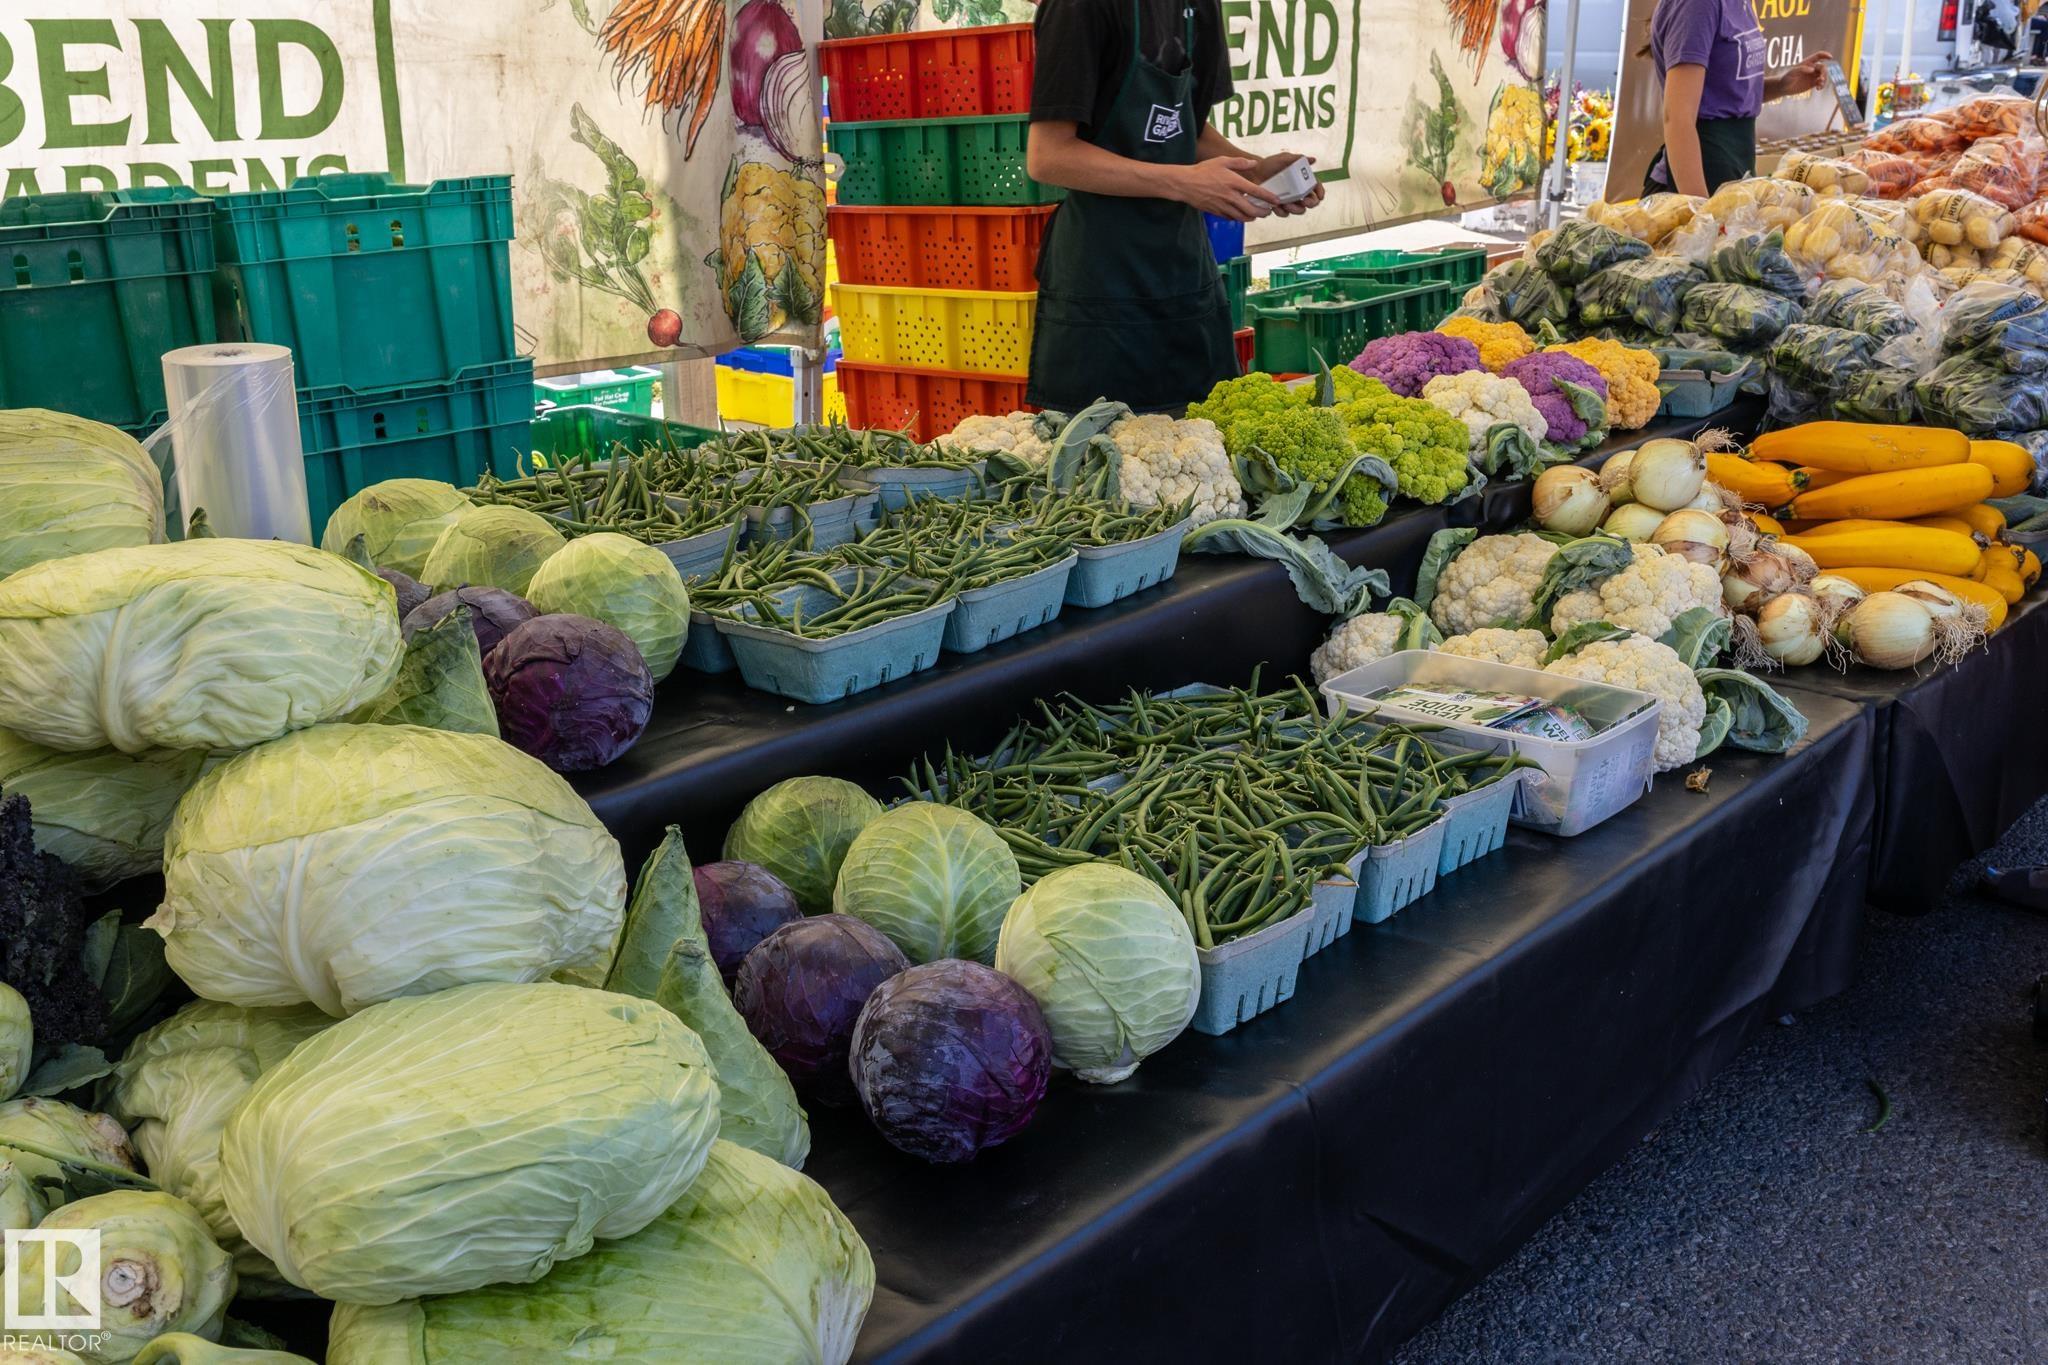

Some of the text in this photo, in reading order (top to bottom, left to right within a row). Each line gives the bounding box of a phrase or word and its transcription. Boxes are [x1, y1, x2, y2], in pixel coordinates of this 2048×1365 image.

[1221, 0, 1339, 81] END
[1764, 34, 1804, 69] CHA
[0, 18, 345, 149] END
[1208, 84, 1336, 138] RDENS
[1407, 698, 1475, 714] GUIDE
